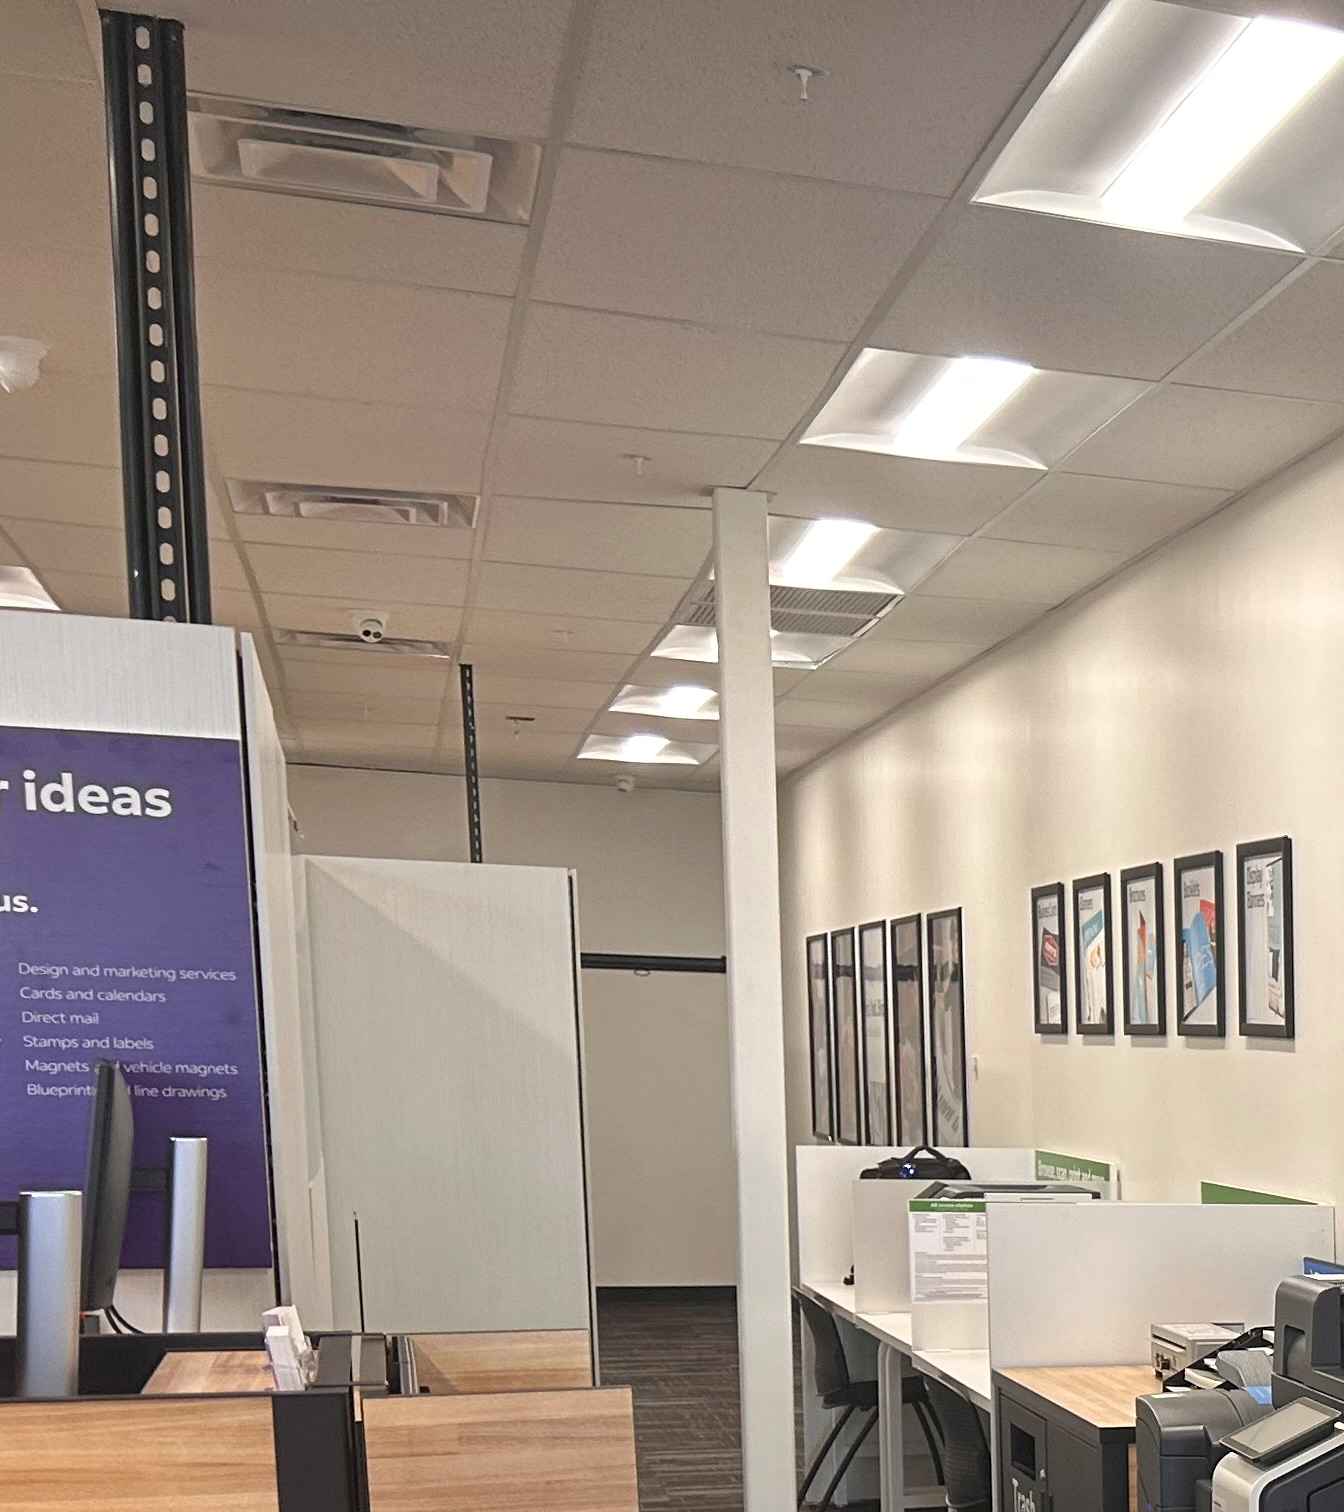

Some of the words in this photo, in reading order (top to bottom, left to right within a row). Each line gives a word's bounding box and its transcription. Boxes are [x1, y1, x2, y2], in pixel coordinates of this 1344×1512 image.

[23, 769, 172, 818] ideas
[18, 962, 68, 979] Design
[72, 964, 100, 977] and
[104, 966, 176, 982] marketing
[180, 968, 237, 981] services
[20, 987, 62, 1000] Cards
[66, 988, 94, 1000] and
[97, 988, 166, 1002] calendars
[21, 1011, 66, 1024] Direct
[70, 1013, 99, 1025] mail
[23, 1035, 78, 1050] Stamps
[82, 1036, 110, 1049] and
[113, 1037, 154, 1050] labels
[25, 1059, 89, 1075] Magnets
[123, 1061, 172, 1074] vehicle
[175, 1062, 239, 1076] magnets
[134, 1085, 159, 1097] line
[162, 1086, 227, 1100] drawings
